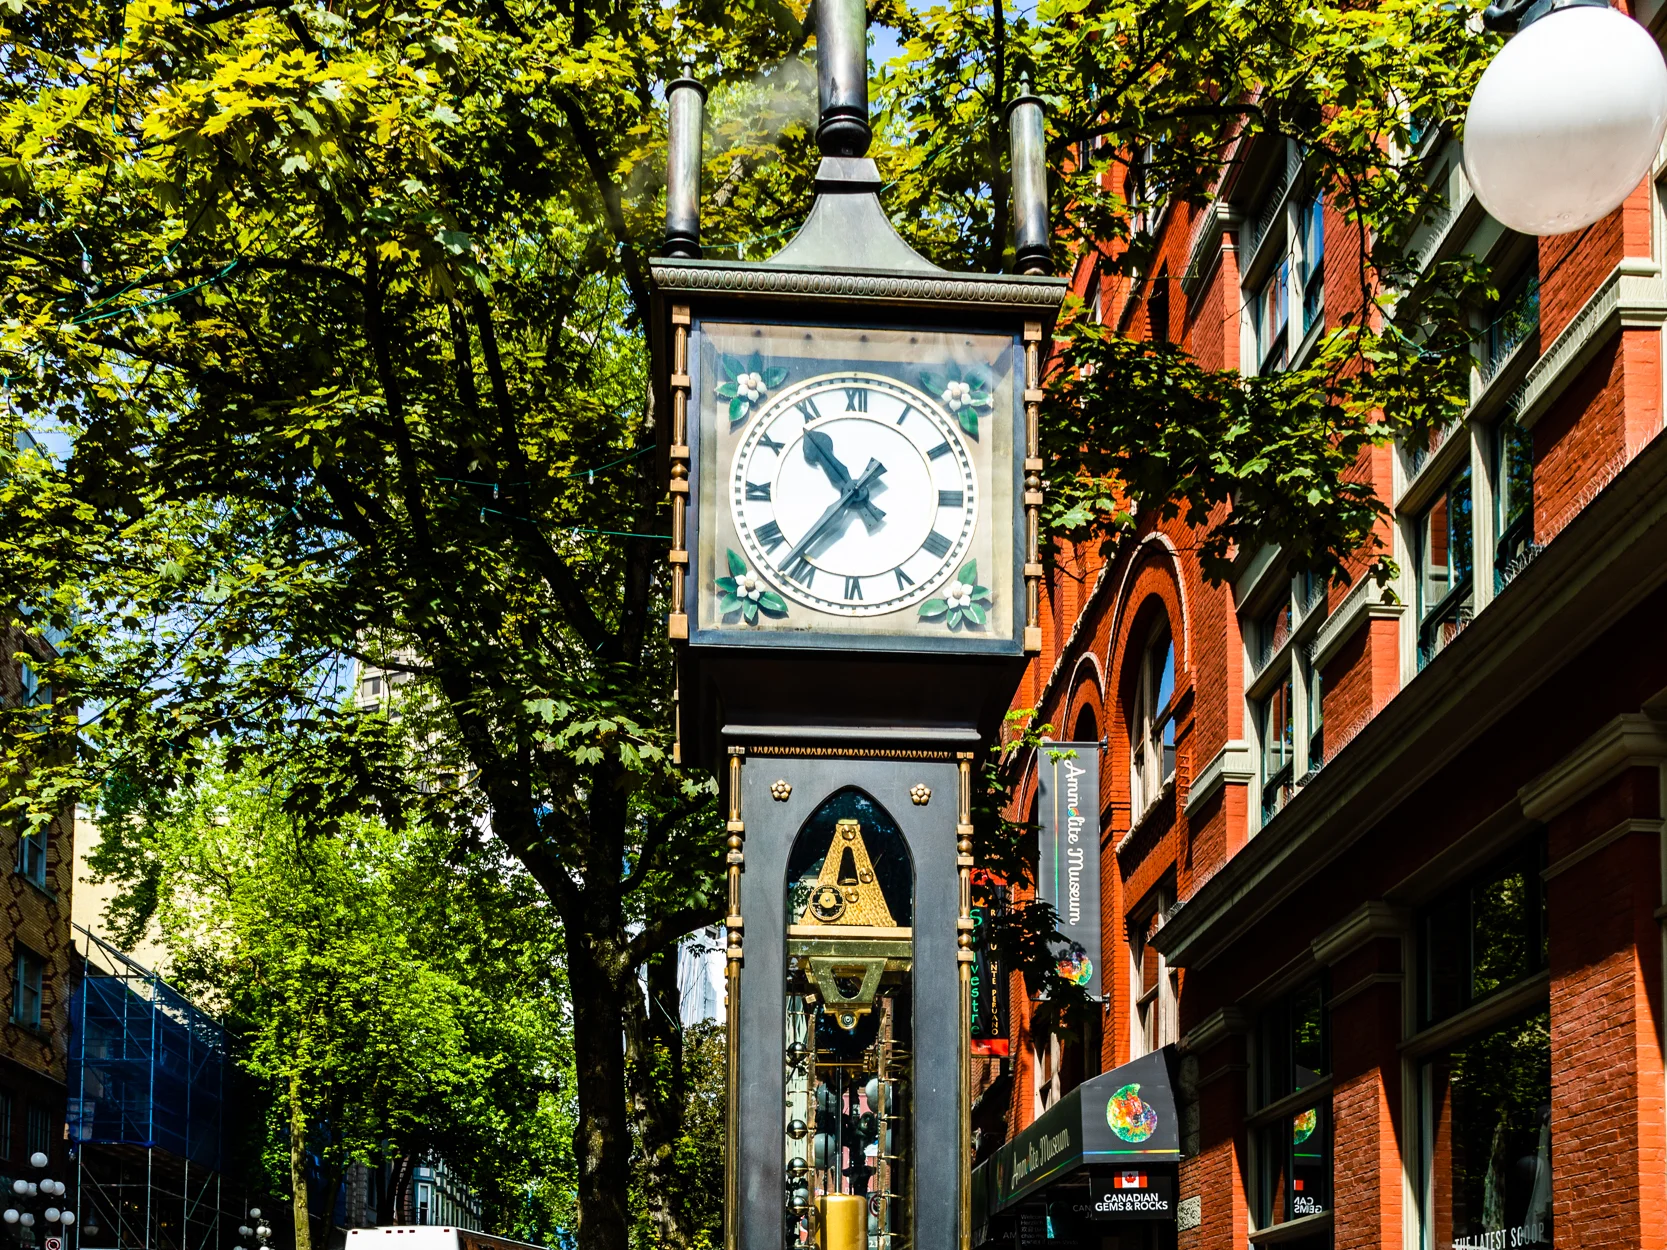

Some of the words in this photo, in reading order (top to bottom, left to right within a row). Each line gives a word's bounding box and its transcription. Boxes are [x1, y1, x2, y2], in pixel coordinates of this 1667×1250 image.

[794, 397, 821, 424] XI
[844, 388, 868, 413] XII
[1064, 760, 1086, 844] Ammolite
[1067, 848, 1084, 926] Museum
[991, 989, 999, 1036] PERUANO
[1095, 1202, 1124, 1211] GEMS
[1125, 1202, 1133, 1211] &
[1134, 1201, 1168, 1211] ROCKS
[1103, 1193, 1158, 1202] CANADIAN
[1511, 1222, 1544, 1248] SCOOP
